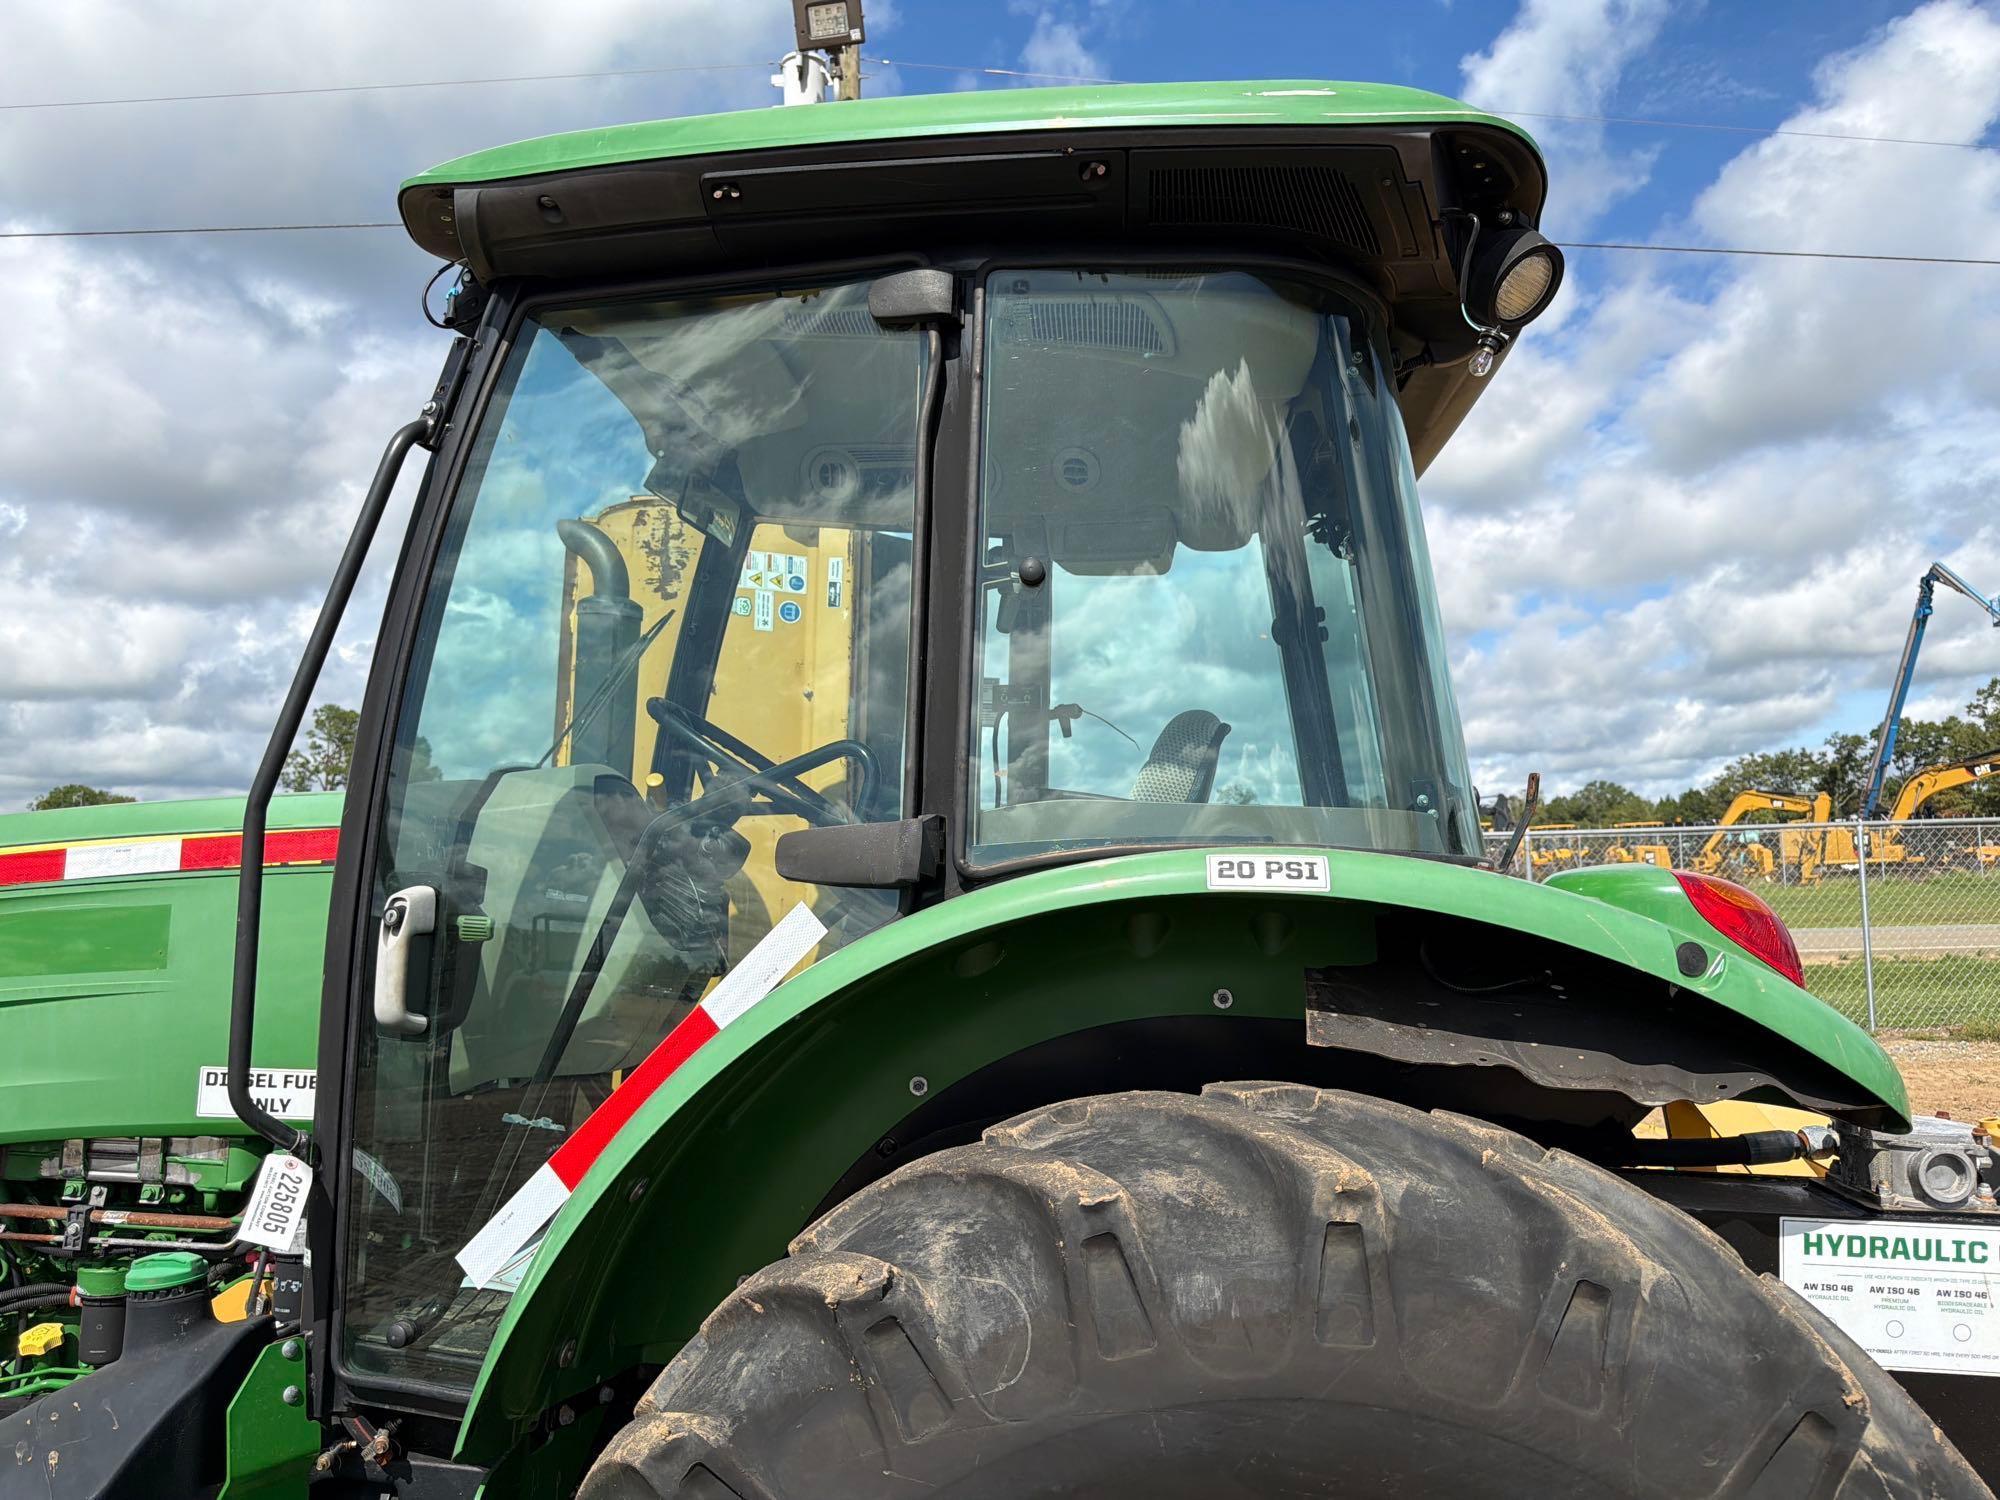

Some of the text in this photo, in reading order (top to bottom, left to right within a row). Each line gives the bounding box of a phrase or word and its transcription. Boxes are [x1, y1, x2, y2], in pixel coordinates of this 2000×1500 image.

[1217, 860, 1319, 880] 20 PSI
[205, 1072, 317, 1089] DISEL FUE
[252, 1098, 291, 1113] NLY
[262, 1167, 303, 1234] 225805
[1803, 1232, 1989, 1264] HYDRAULIC
[1821, 1283, 1838, 1291] ISO
[1869, 1286, 1885, 1294] AW
[1887, 1287, 1905, 1295] ISO
[1936, 1289, 1988, 1299] AW ISO 46
